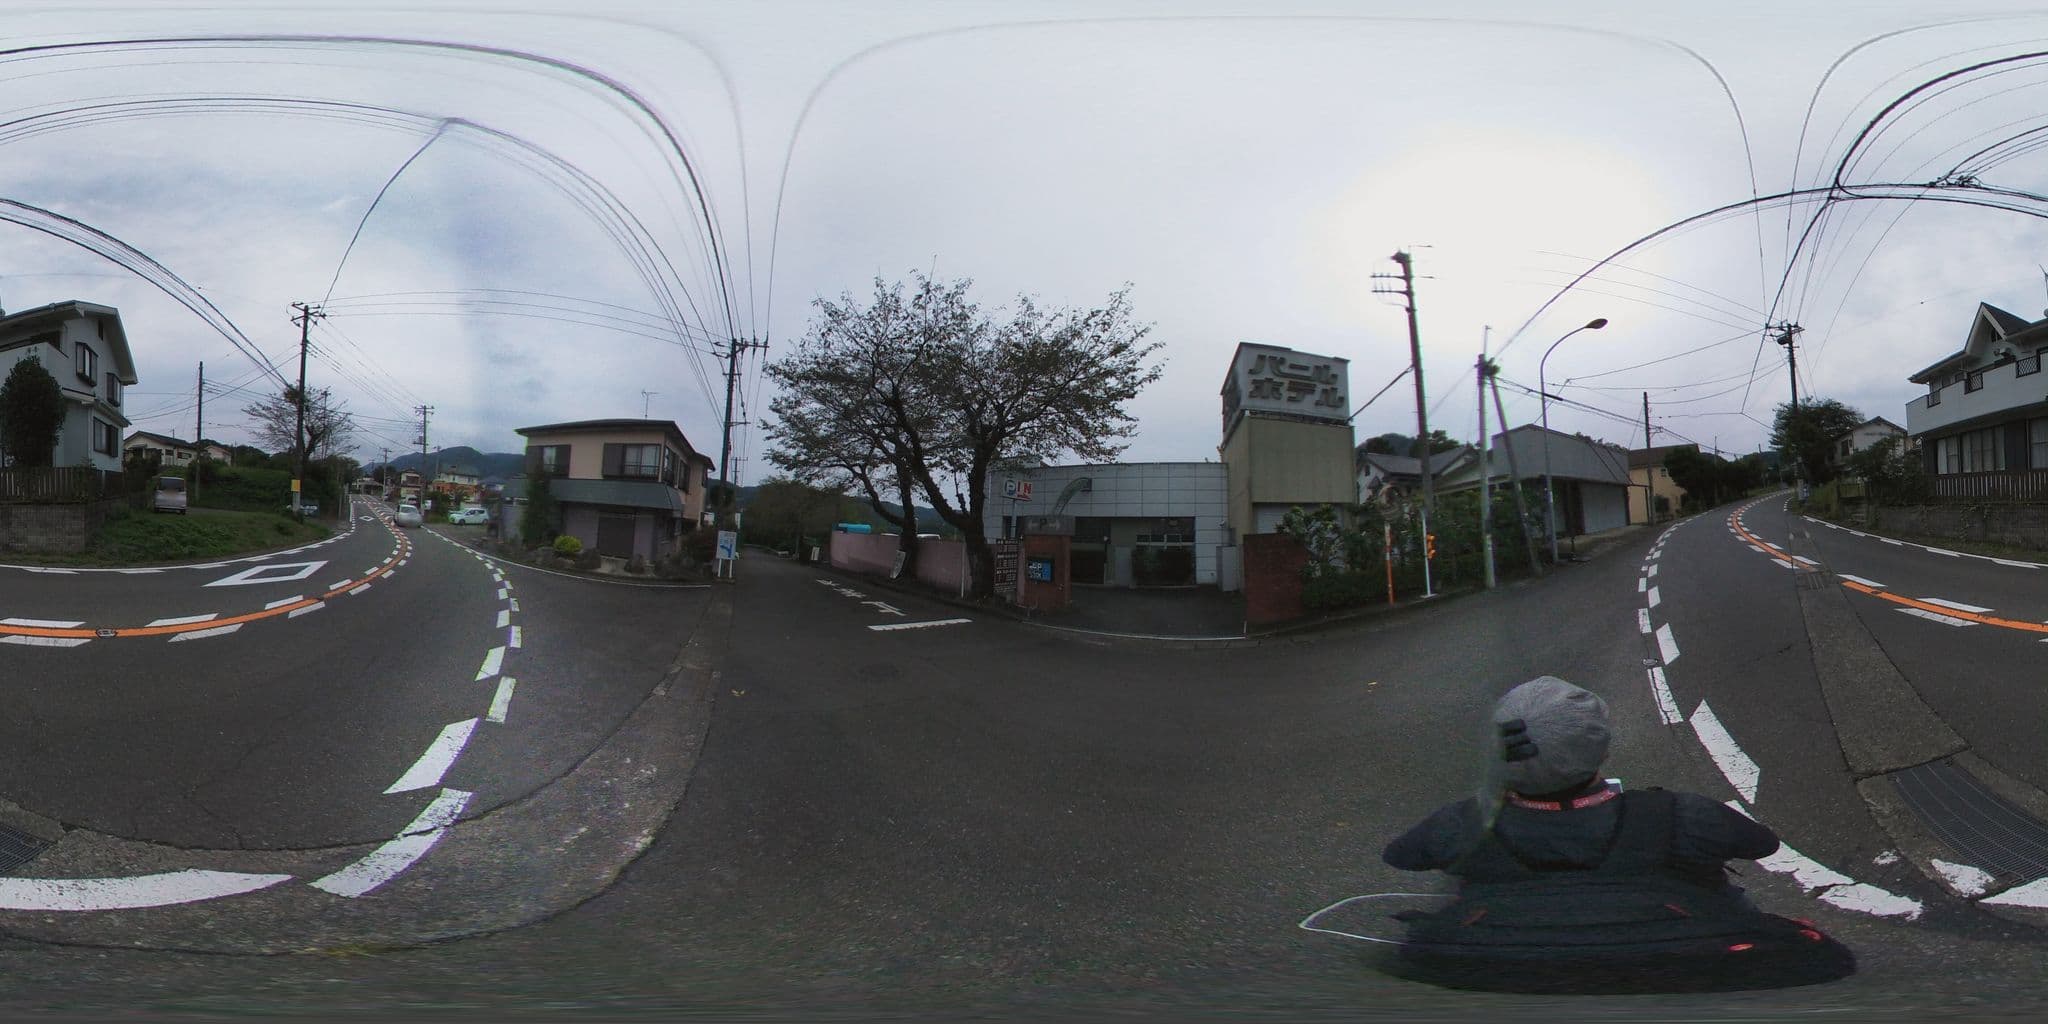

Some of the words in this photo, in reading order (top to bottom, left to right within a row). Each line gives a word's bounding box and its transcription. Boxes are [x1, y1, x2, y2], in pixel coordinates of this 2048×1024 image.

[1248, 377, 1345, 408] ホテル
[1017, 480, 1032, 494] IN
